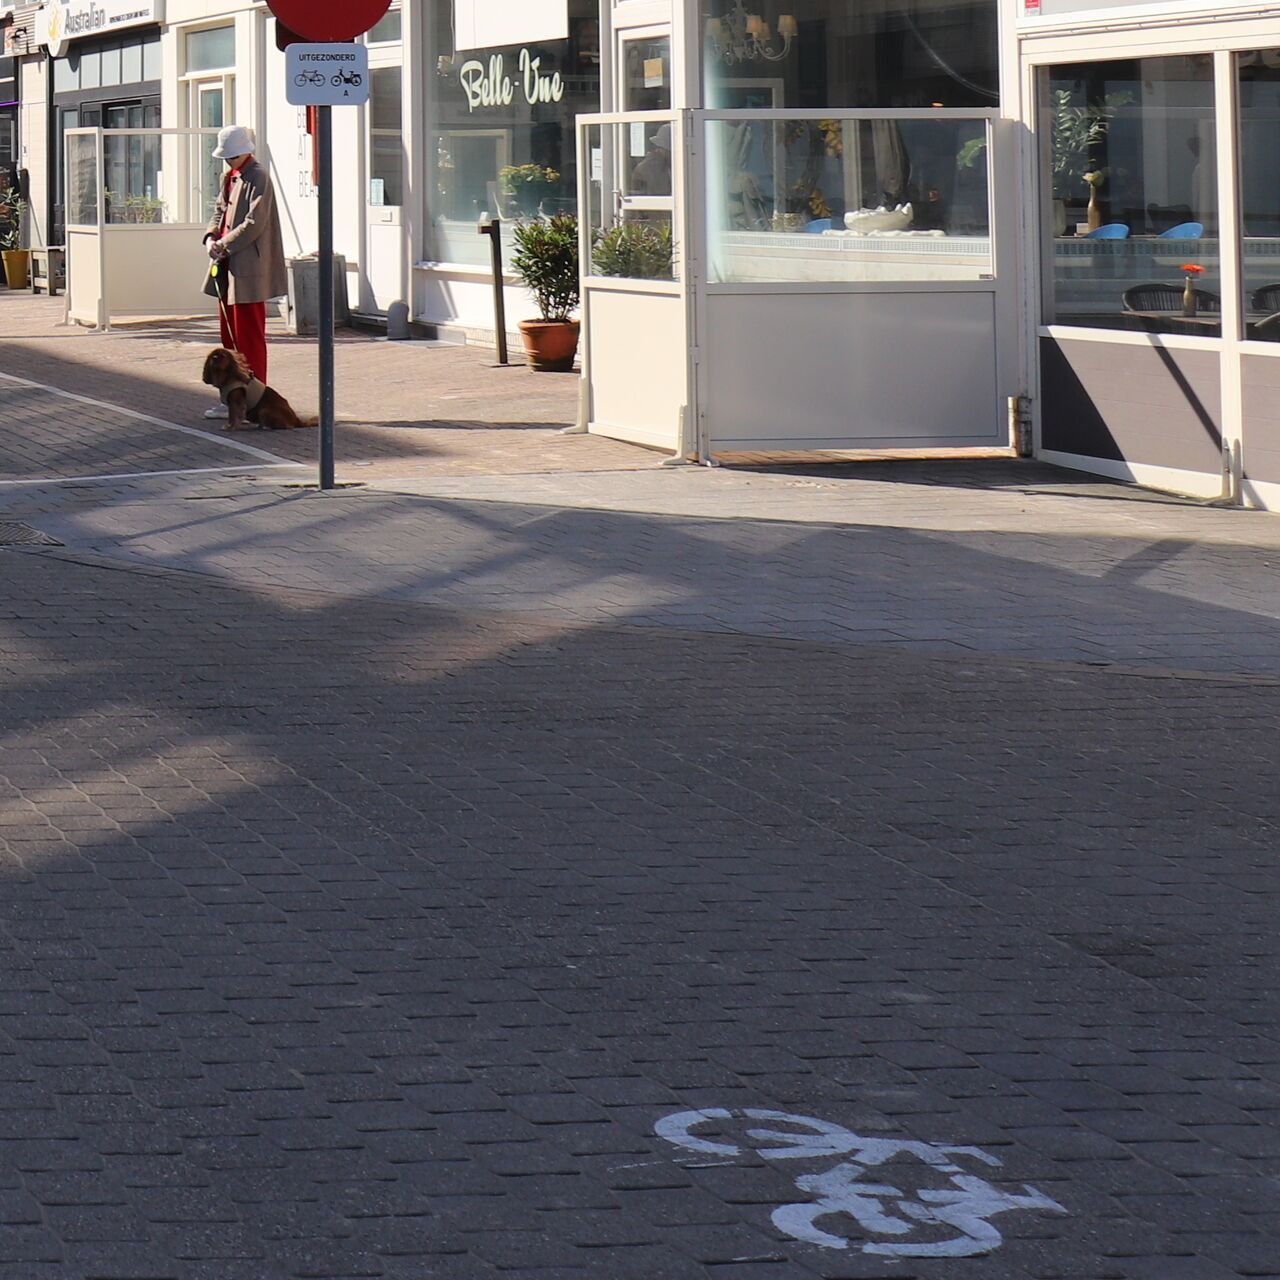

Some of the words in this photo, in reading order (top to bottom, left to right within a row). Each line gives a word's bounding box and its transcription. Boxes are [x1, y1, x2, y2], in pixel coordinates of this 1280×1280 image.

[64, 2, 106, 35] Australian
[298, 53, 356, 62] UITGEZONDERD
[460, 48, 564, 113] Belle-Vue
[343, 89, 349, 97] A
